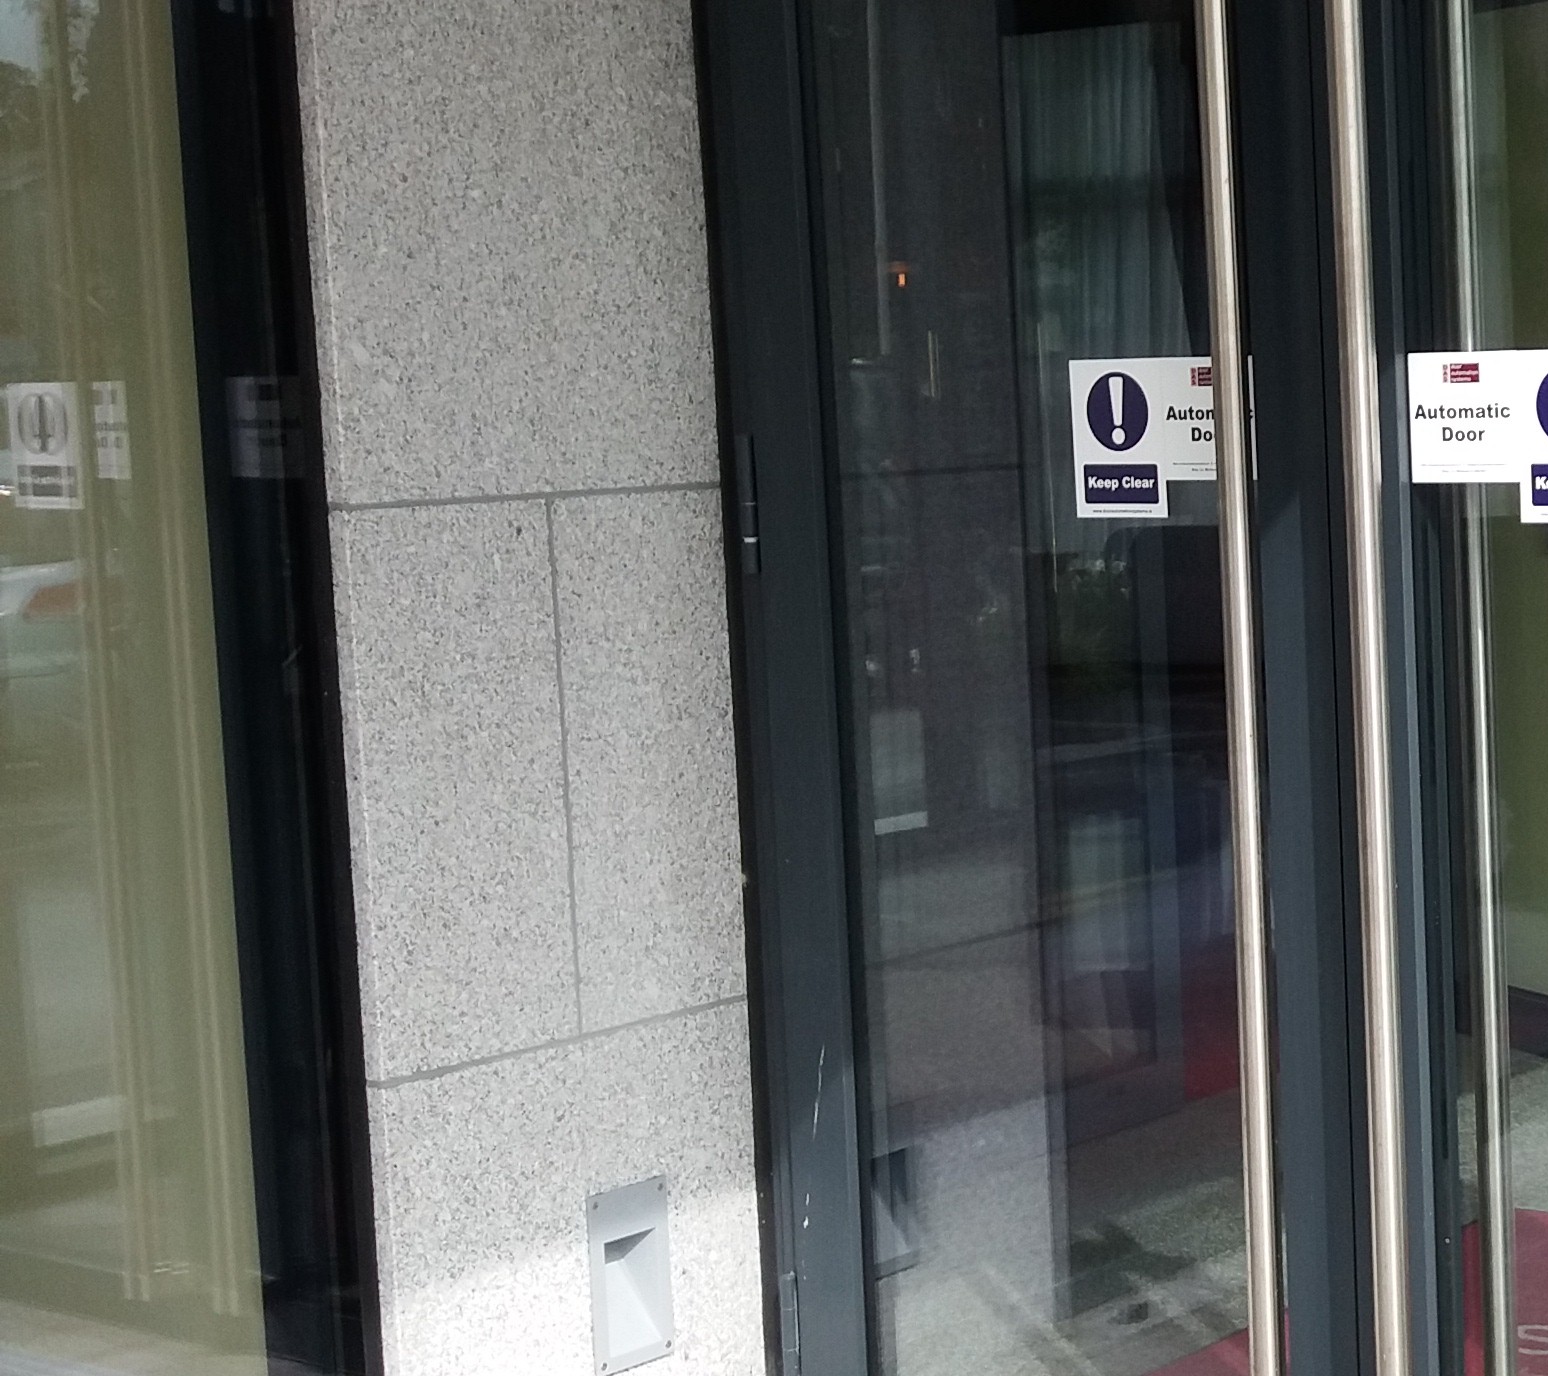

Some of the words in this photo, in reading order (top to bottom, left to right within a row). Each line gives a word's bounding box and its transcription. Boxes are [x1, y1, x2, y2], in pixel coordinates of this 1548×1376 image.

[1414, 403, 1511, 420] Automatic
[1191, 427, 1216, 442] Do
[1442, 427, 1486, 442] Door
[1088, 476, 1119, 491] Keep
[1121, 476, 1155, 490] Clear
